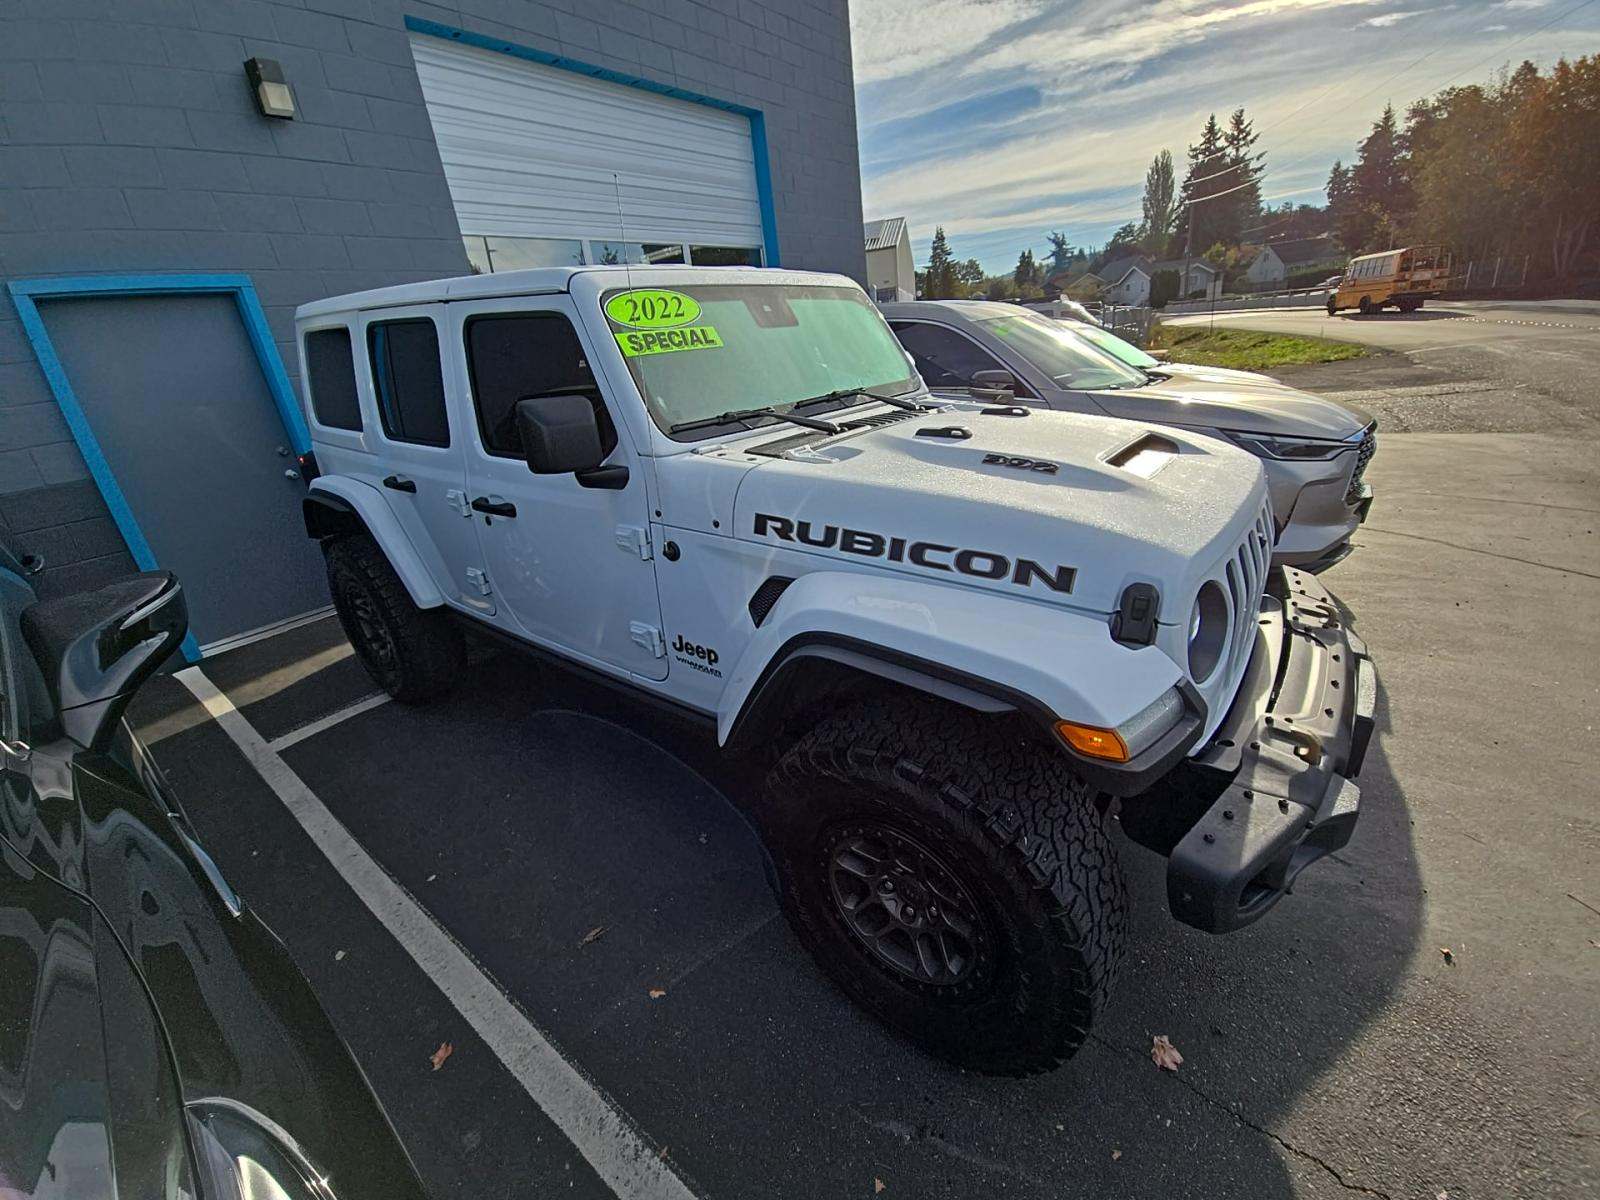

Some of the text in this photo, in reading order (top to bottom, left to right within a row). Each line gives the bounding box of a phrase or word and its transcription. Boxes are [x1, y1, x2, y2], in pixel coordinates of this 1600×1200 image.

[625, 296, 685, 322] 2022
[627, 328, 715, 352] SPECIAL
[753, 512, 1078, 594] RUBICON
[672, 634, 719, 666] Jeep
